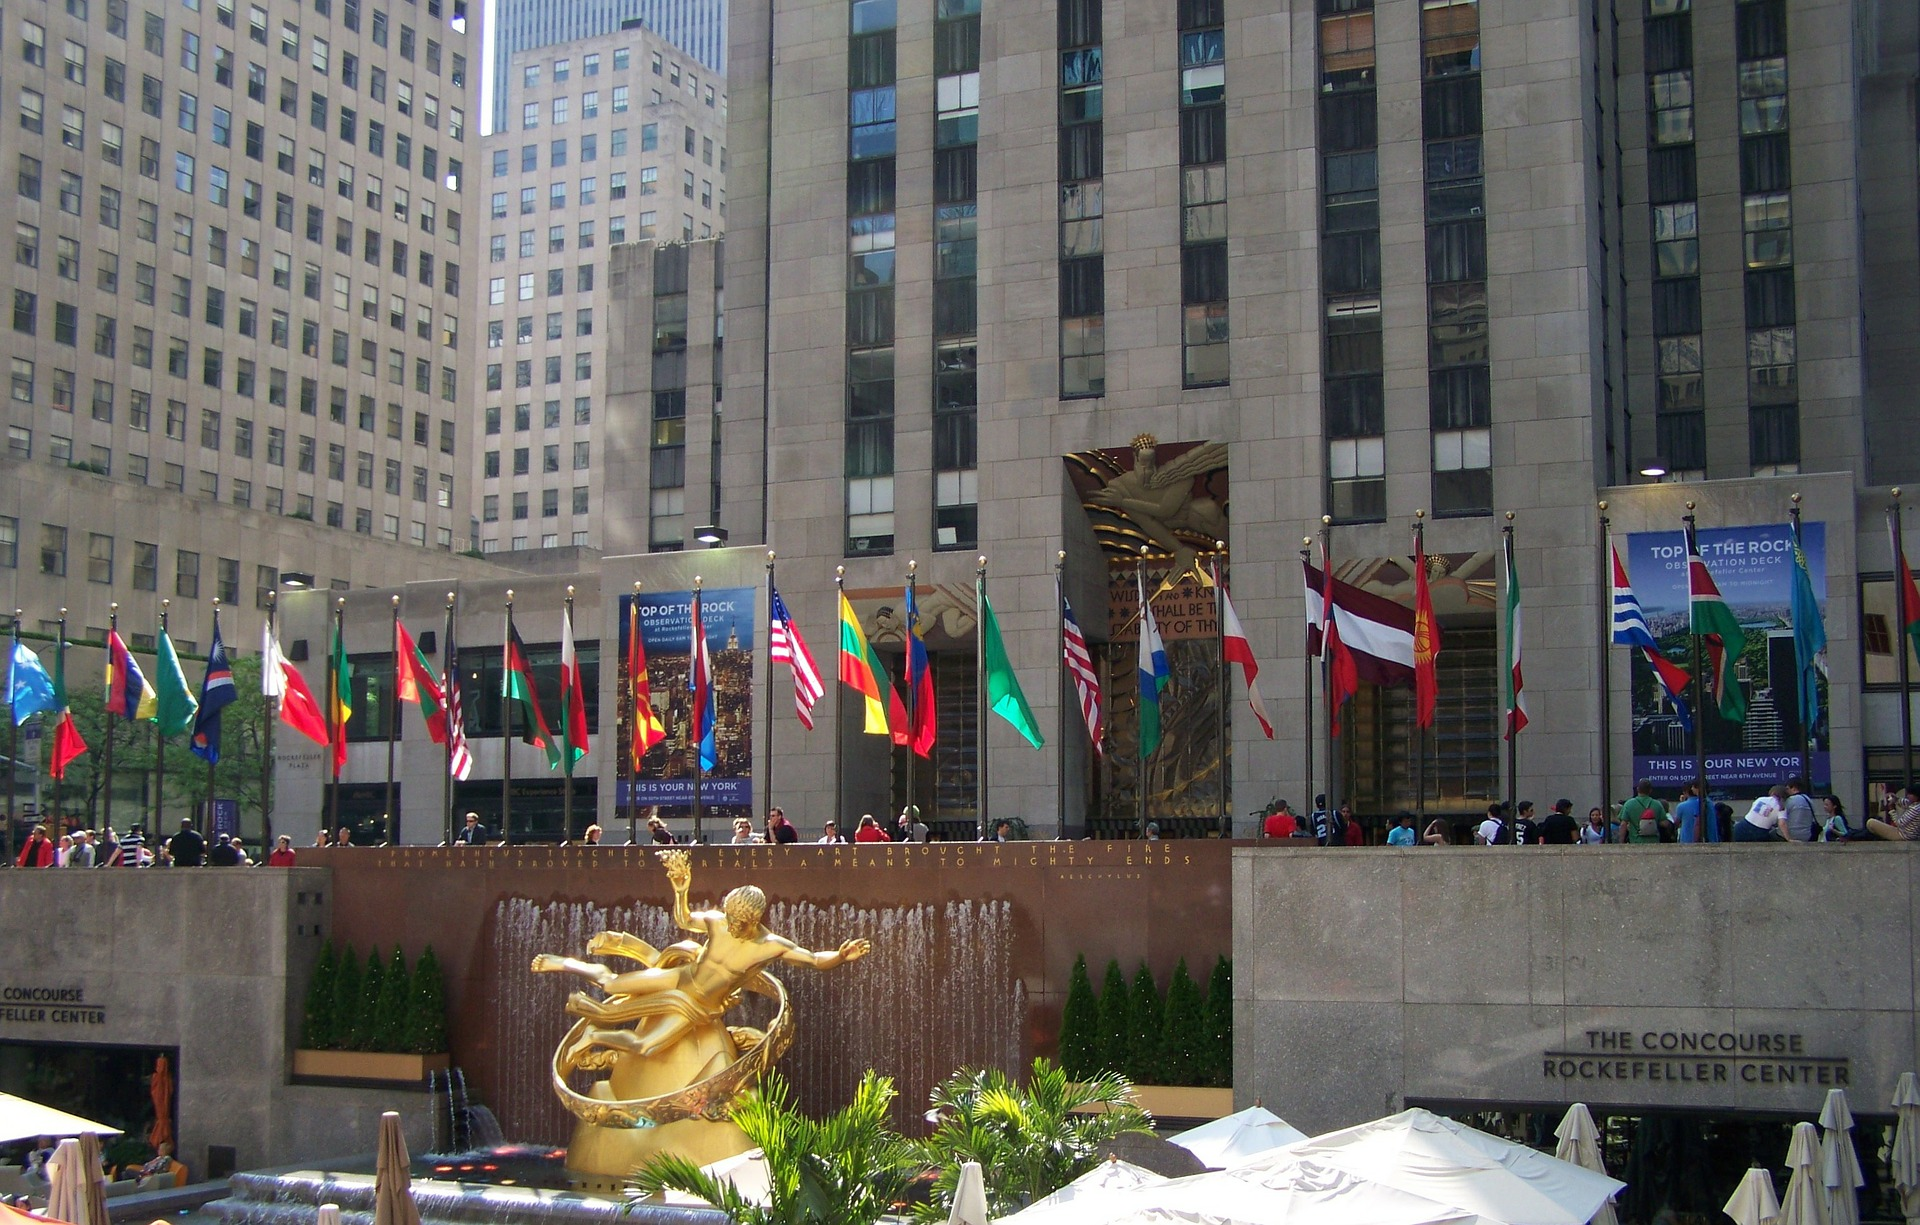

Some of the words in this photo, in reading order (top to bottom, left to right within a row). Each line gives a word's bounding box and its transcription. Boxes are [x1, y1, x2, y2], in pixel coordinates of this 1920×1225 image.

[1651, 546, 1683, 558] TOP
[1713, 543, 1745, 556] THE
[1749, 540, 1791, 553] ROCK
[1666, 559, 1746, 570] OBSVATION
[1751, 556, 1781, 566] DECK
[639, 605, 658, 617] OP
[659, 605, 675, 616] OF
[676, 603, 692, 614] TH
[701, 602, 735, 613] ROCK
[1151, 604, 1186, 617] SHALL
[1188, 602, 1203, 616] BE
[643, 618, 692, 626] OBSERVATIO
[1110, 621, 1171, 636] STABTY
[1173, 620, 1192, 633] OF
[1648, 760, 1676, 769] THIS
[1680, 760, 1692, 769] IS
[1704, 759, 1732, 769] OUR
[1736, 758, 1767, 768] NEW
[1772, 757, 1800, 767] YOR
[649, 783, 657, 791] IS
[660, 783, 684, 791] YOUR
[711, 782, 737, 790] YORK
[548, 849, 645, 857] TEACHER
[718, 848, 790, 856] EVERY
[817, 847, 857, 856] ART
[886, 846, 1000, 855] BROUGHT
[1107, 844, 1170, 853] FIRE
[446, 860, 494, 868] HATH
[702, 859, 773, 868] RTALS
[800, 858, 807, 867] A
[834, 858, 910, 867] MEANS
[940, 858, 964, 867] TO
[993, 857, 1094, 866] MIGHTY
[1126, 856, 1190, 865] ENDS
[3, 987, 84, 1002] CONCOURSE
[51, 1009, 106, 1024] CENTER
[1586, 1031, 1632, 1049] THE
[1642, 1032, 1803, 1052] CONCOURSE
[1543, 1060, 1727, 1082] ROCKEFELLER
[1741, 1064, 1849, 1085] CENTER
